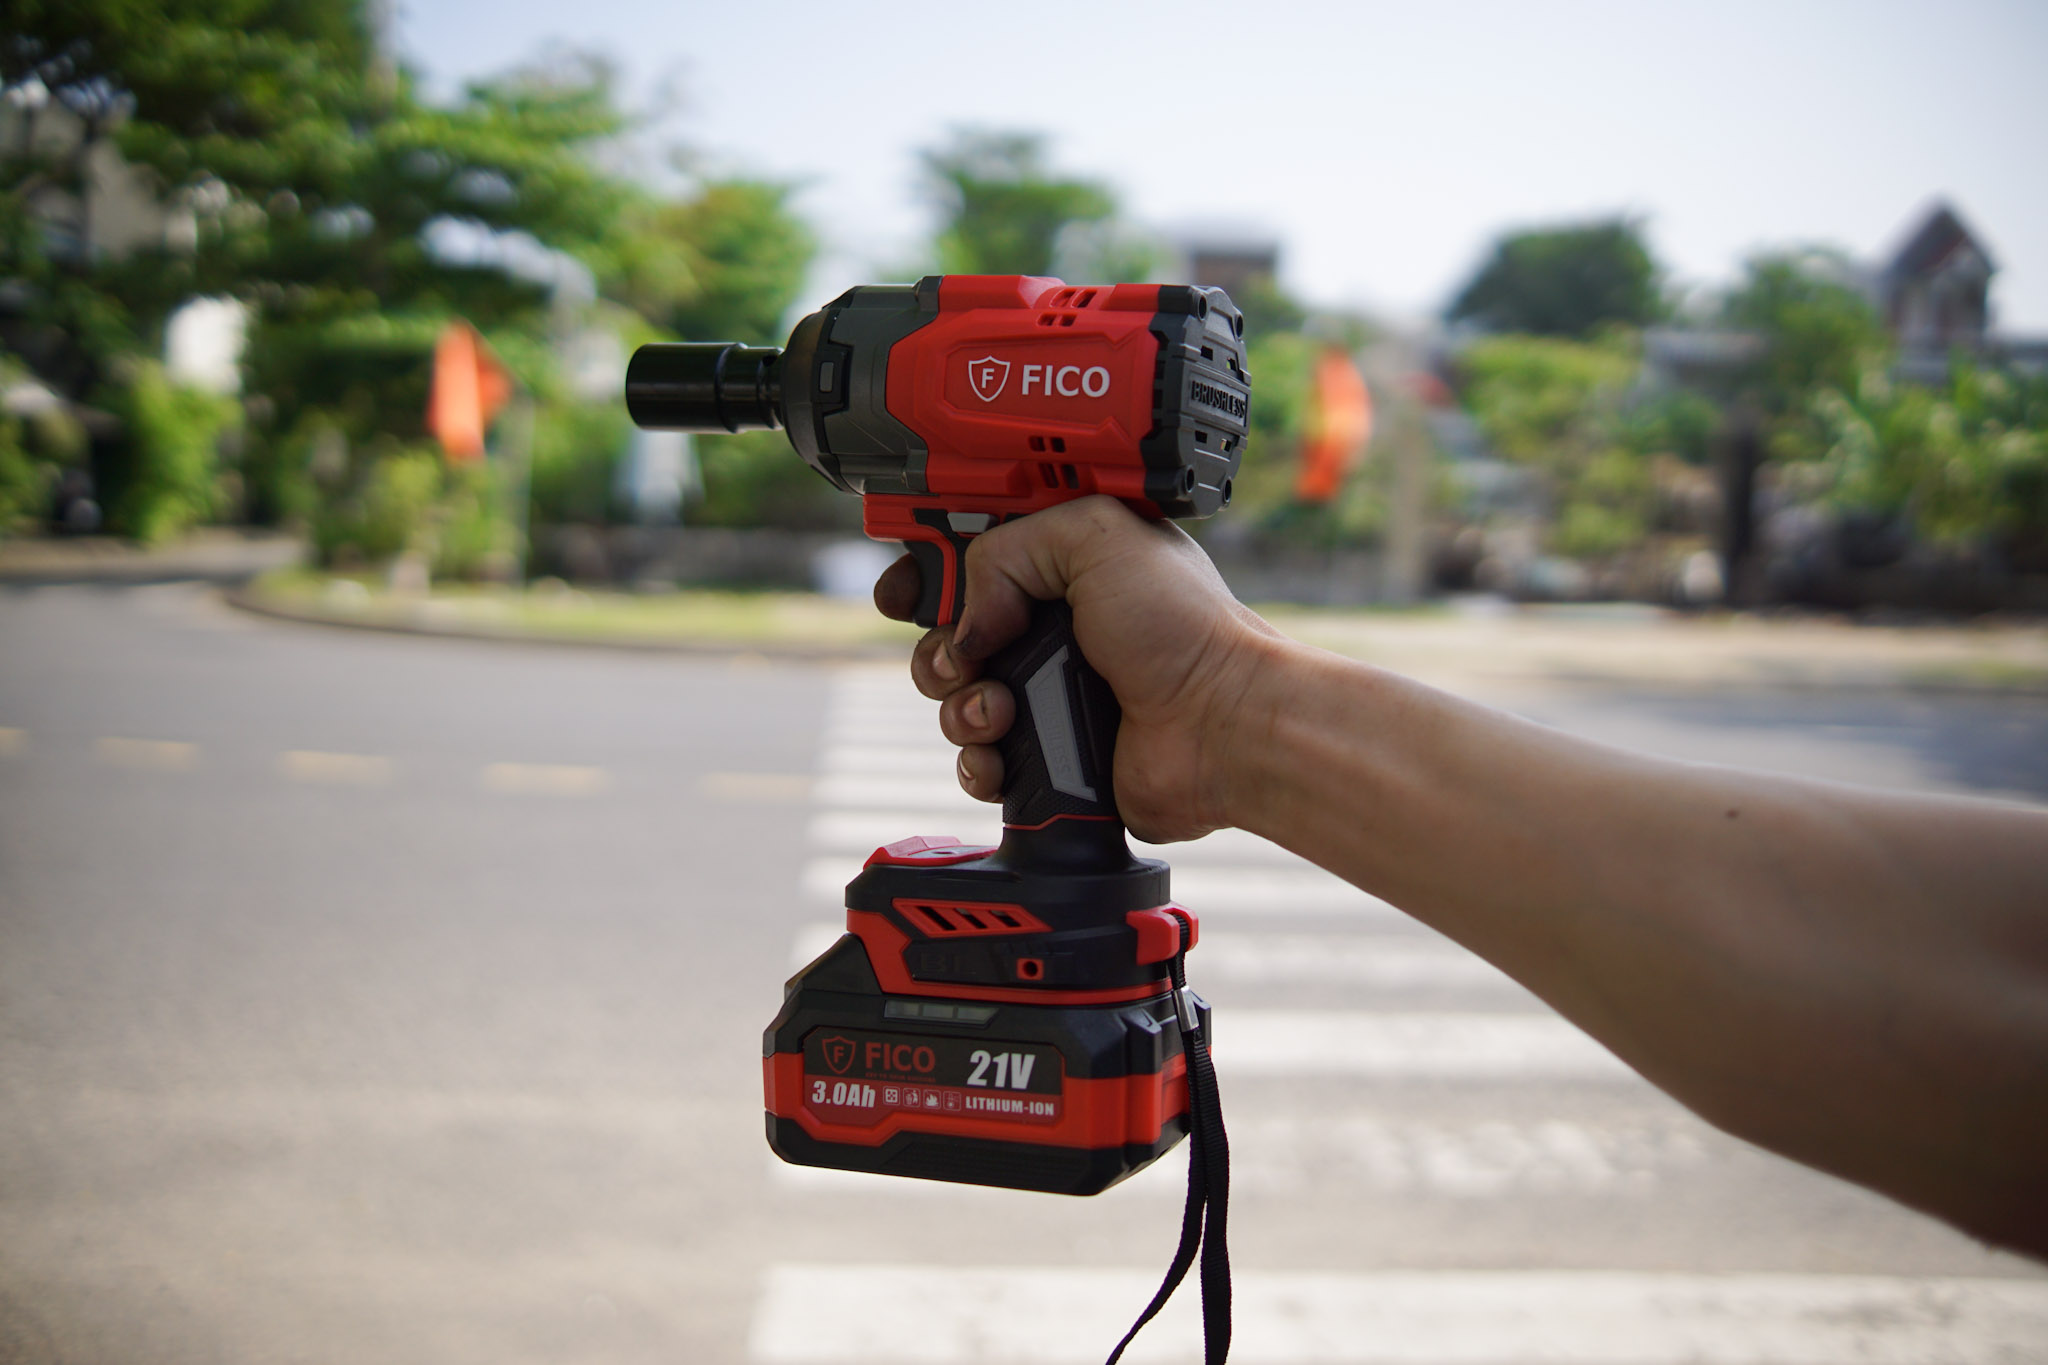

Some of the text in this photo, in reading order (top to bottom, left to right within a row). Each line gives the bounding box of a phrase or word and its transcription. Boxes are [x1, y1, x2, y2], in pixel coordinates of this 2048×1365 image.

[981, 364, 1111, 398] F FICO
[1191, 380, 1246, 418] BRUSHLESS
[833, 1042, 936, 1073] F FICO
[967, 1050, 1036, 1090] 21V
[812, 1081, 876, 1108] 3.0Ah
[965, 1096, 1055, 1116] LITHIUM-ION
